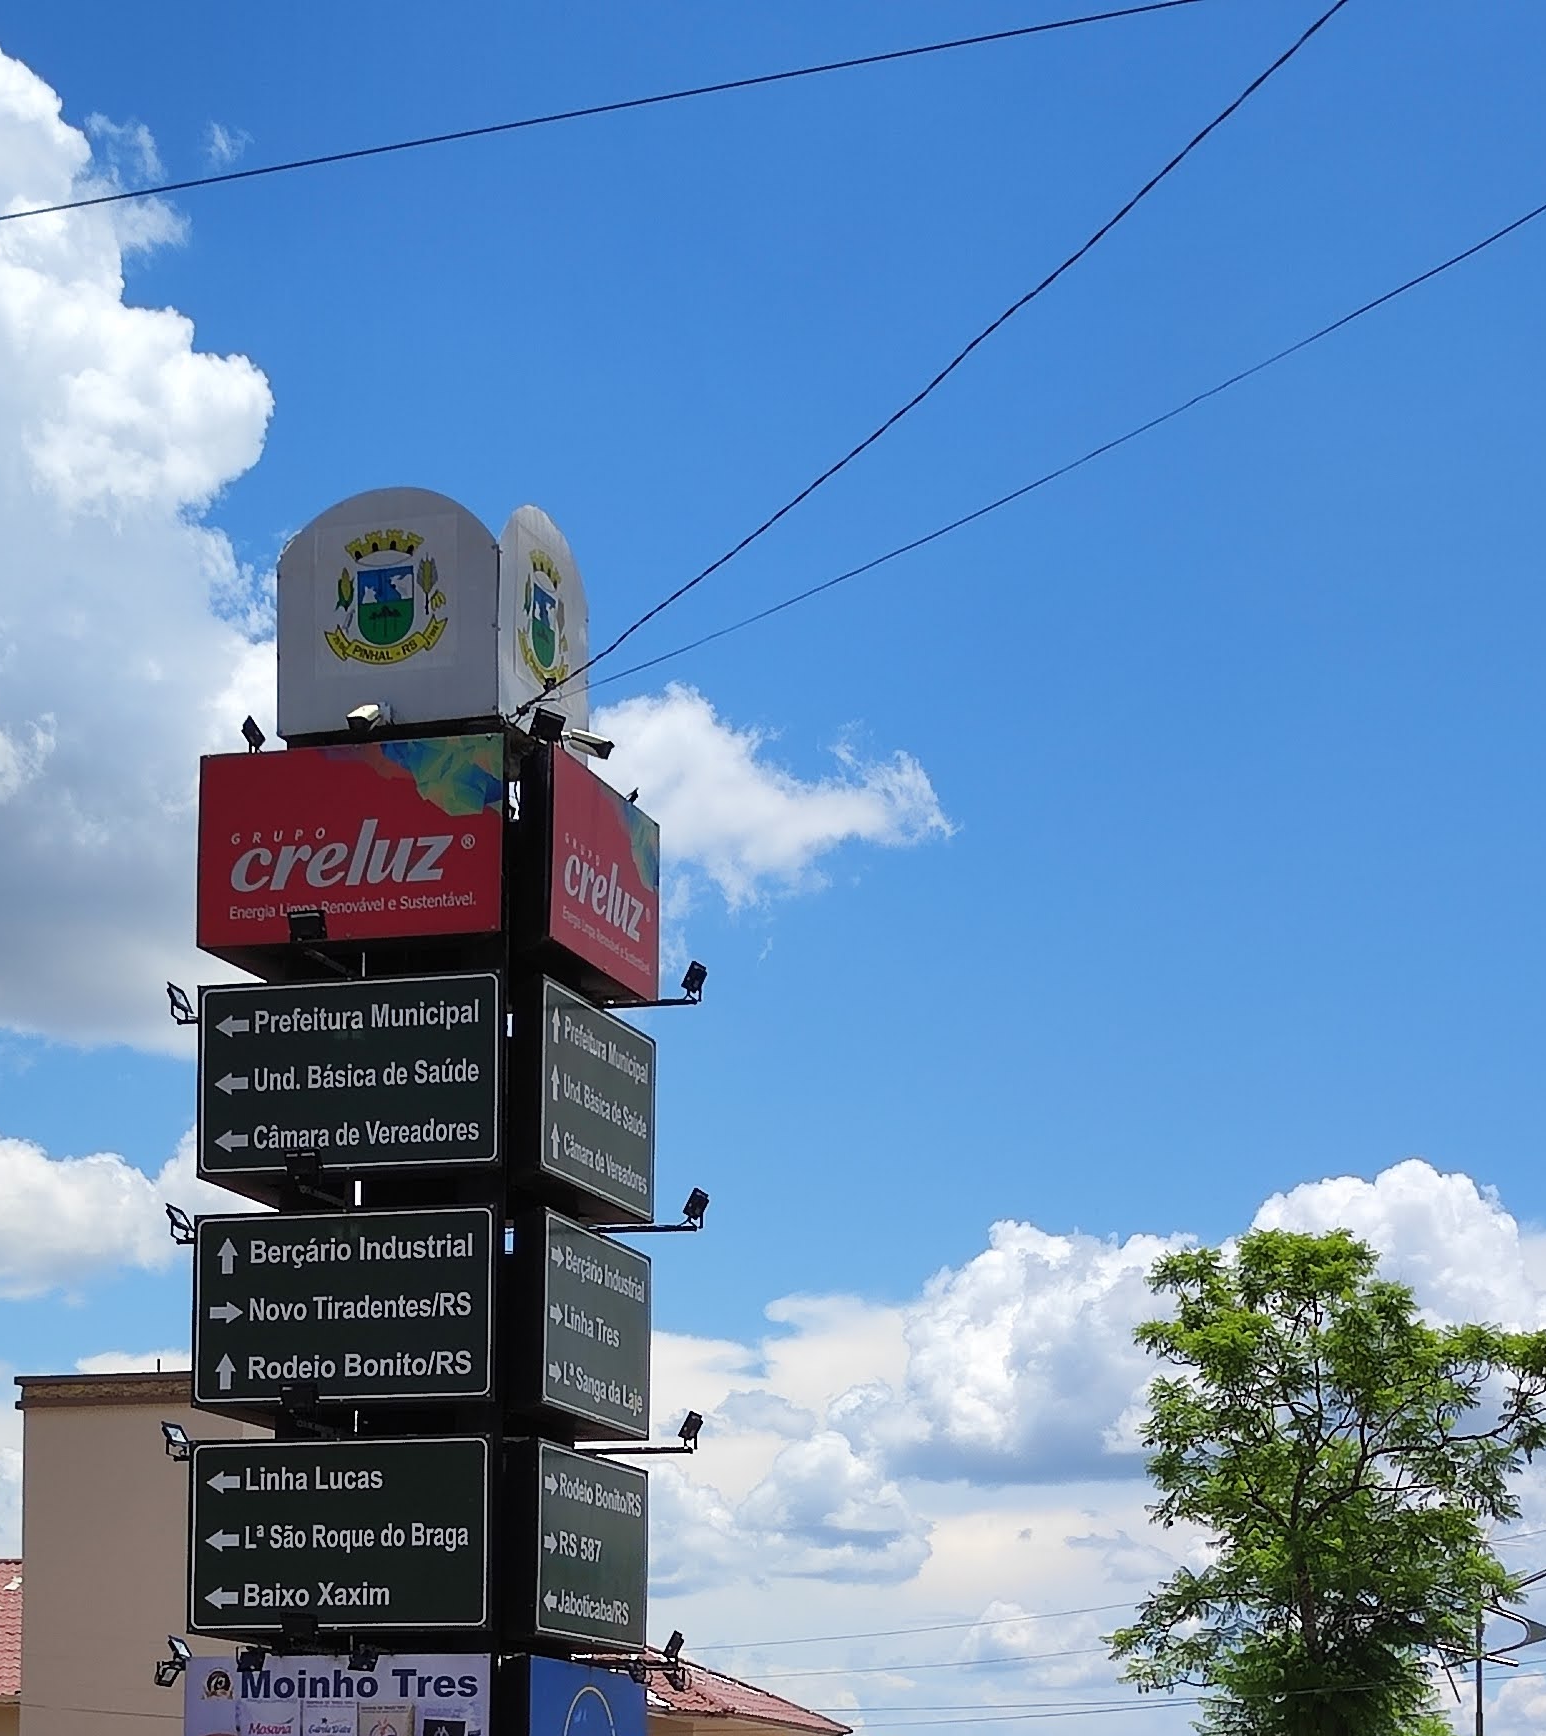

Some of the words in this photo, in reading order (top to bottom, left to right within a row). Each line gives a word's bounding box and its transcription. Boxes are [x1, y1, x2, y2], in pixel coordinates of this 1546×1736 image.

[353, 645, 394, 661] PINHAL
[401, 641, 418, 655] RS
[230, 827, 327, 845] GRUPO
[230, 818, 454, 892] creluz
[229, 904, 276, 921] Energia
[321, 897, 385, 914] Renovável
[388, 899, 396, 911] e
[564, 854, 644, 943] creluz
[255, 1007, 364, 1034] Prefeitura
[371, 999, 480, 1030] Municipal
[564, 1015, 606, 1061] Prefeitura
[608, 1040, 648, 1085] Municipal
[254, 1067, 301, 1093] Und.
[307, 1063, 377, 1089] Básica
[383, 1062, 408, 1086] de
[414, 1058, 480, 1084] Saúde
[611, 1101, 621, 1126] de
[254, 1125, 329, 1149] Câmara
[335, 1122, 360, 1146] de
[365, 1118, 480, 1145] Vereadores
[595, 1148, 604, 1175] de
[605, 1152, 647, 1195] Vereadores
[249, 1238, 352, 1269] Berçário
[358, 1233, 474, 1261] Industrial
[565, 1246, 603, 1285] Berçário
[604, 1263, 645, 1304] Industrial
[248, 1296, 307, 1322] Novo
[312, 1292, 472, 1321] Tiradentes/RS
[564, 1303, 594, 1339] Linha
[596, 1317, 620, 1348] Tres
[247, 1355, 336, 1381] Rodeio
[343, 1350, 472, 1377] Bonito/RS
[575, 1366, 606, 1403] Sanga
[608, 1379, 621, 1405] da
[622, 1384, 643, 1417] Laje
[245, 1467, 308, 1491] Linha
[314, 1465, 383, 1489] Lucas
[559, 1472, 594, 1506] Rodeio
[595, 1482, 642, 1518] Bonito/RS
[269, 1525, 307, 1549] São
[312, 1525, 376, 1554] Roque
[380, 1522, 406, 1547] do
[410, 1522, 470, 1552] Braga
[559, 1530, 578, 1558] RS
[580, 1535, 602, 1563] 587
[243, 1582, 310, 1608] Baixo
[317, 1581, 391, 1606] Xaxim
[558, 1588, 630, 1626] Jaboticaba/RS
[241, 1669, 379, 1698] Moinho
[392, 1668, 479, 1698] Tres
[248, 1722, 292, 1735] Mosana
